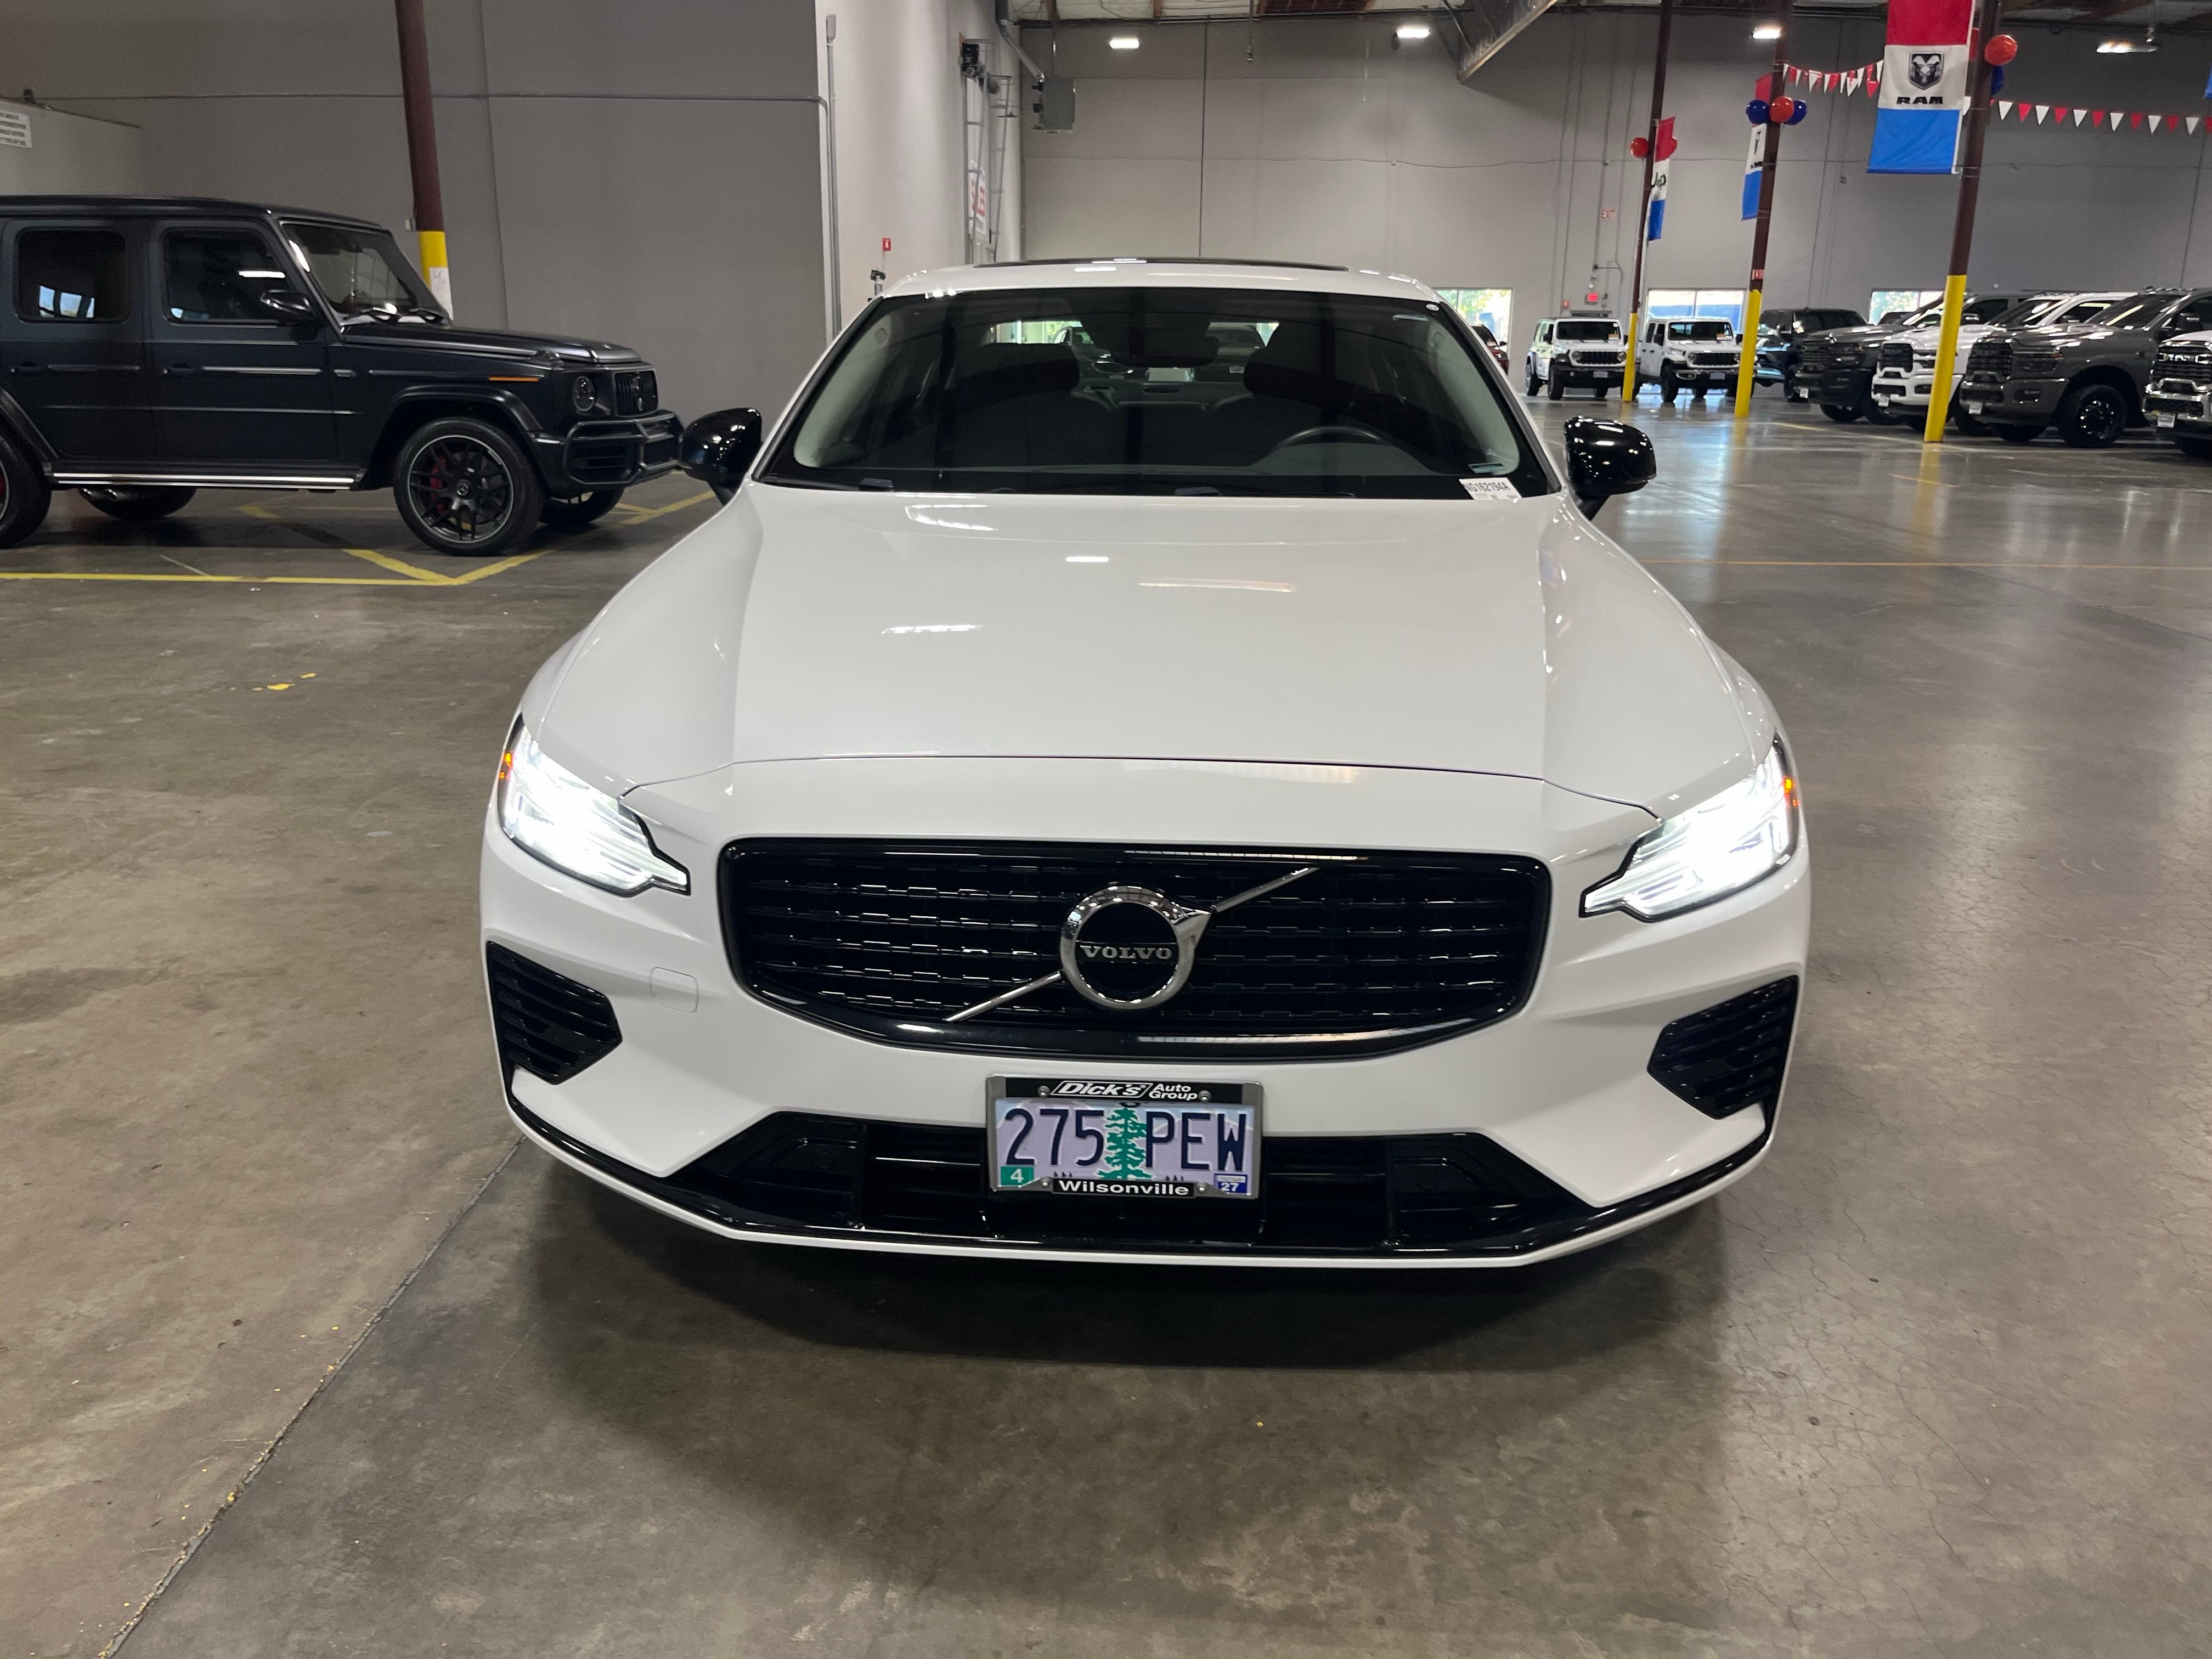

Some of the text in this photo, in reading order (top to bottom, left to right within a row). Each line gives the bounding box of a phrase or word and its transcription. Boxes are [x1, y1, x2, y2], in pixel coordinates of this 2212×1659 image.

[1896, 96, 1943, 105] RAM
[1080, 945, 1172, 960] VOLVO
[1152, 1083, 1192, 1092] Auto
[1148, 1091, 1198, 1101] Group
[1005, 1108, 1247, 1171] 275 PEW
[1010, 1168, 1024, 1183] 4
[1058, 1180, 1190, 1195] Wilsonville
[1221, 1182, 1239, 1192] 27
